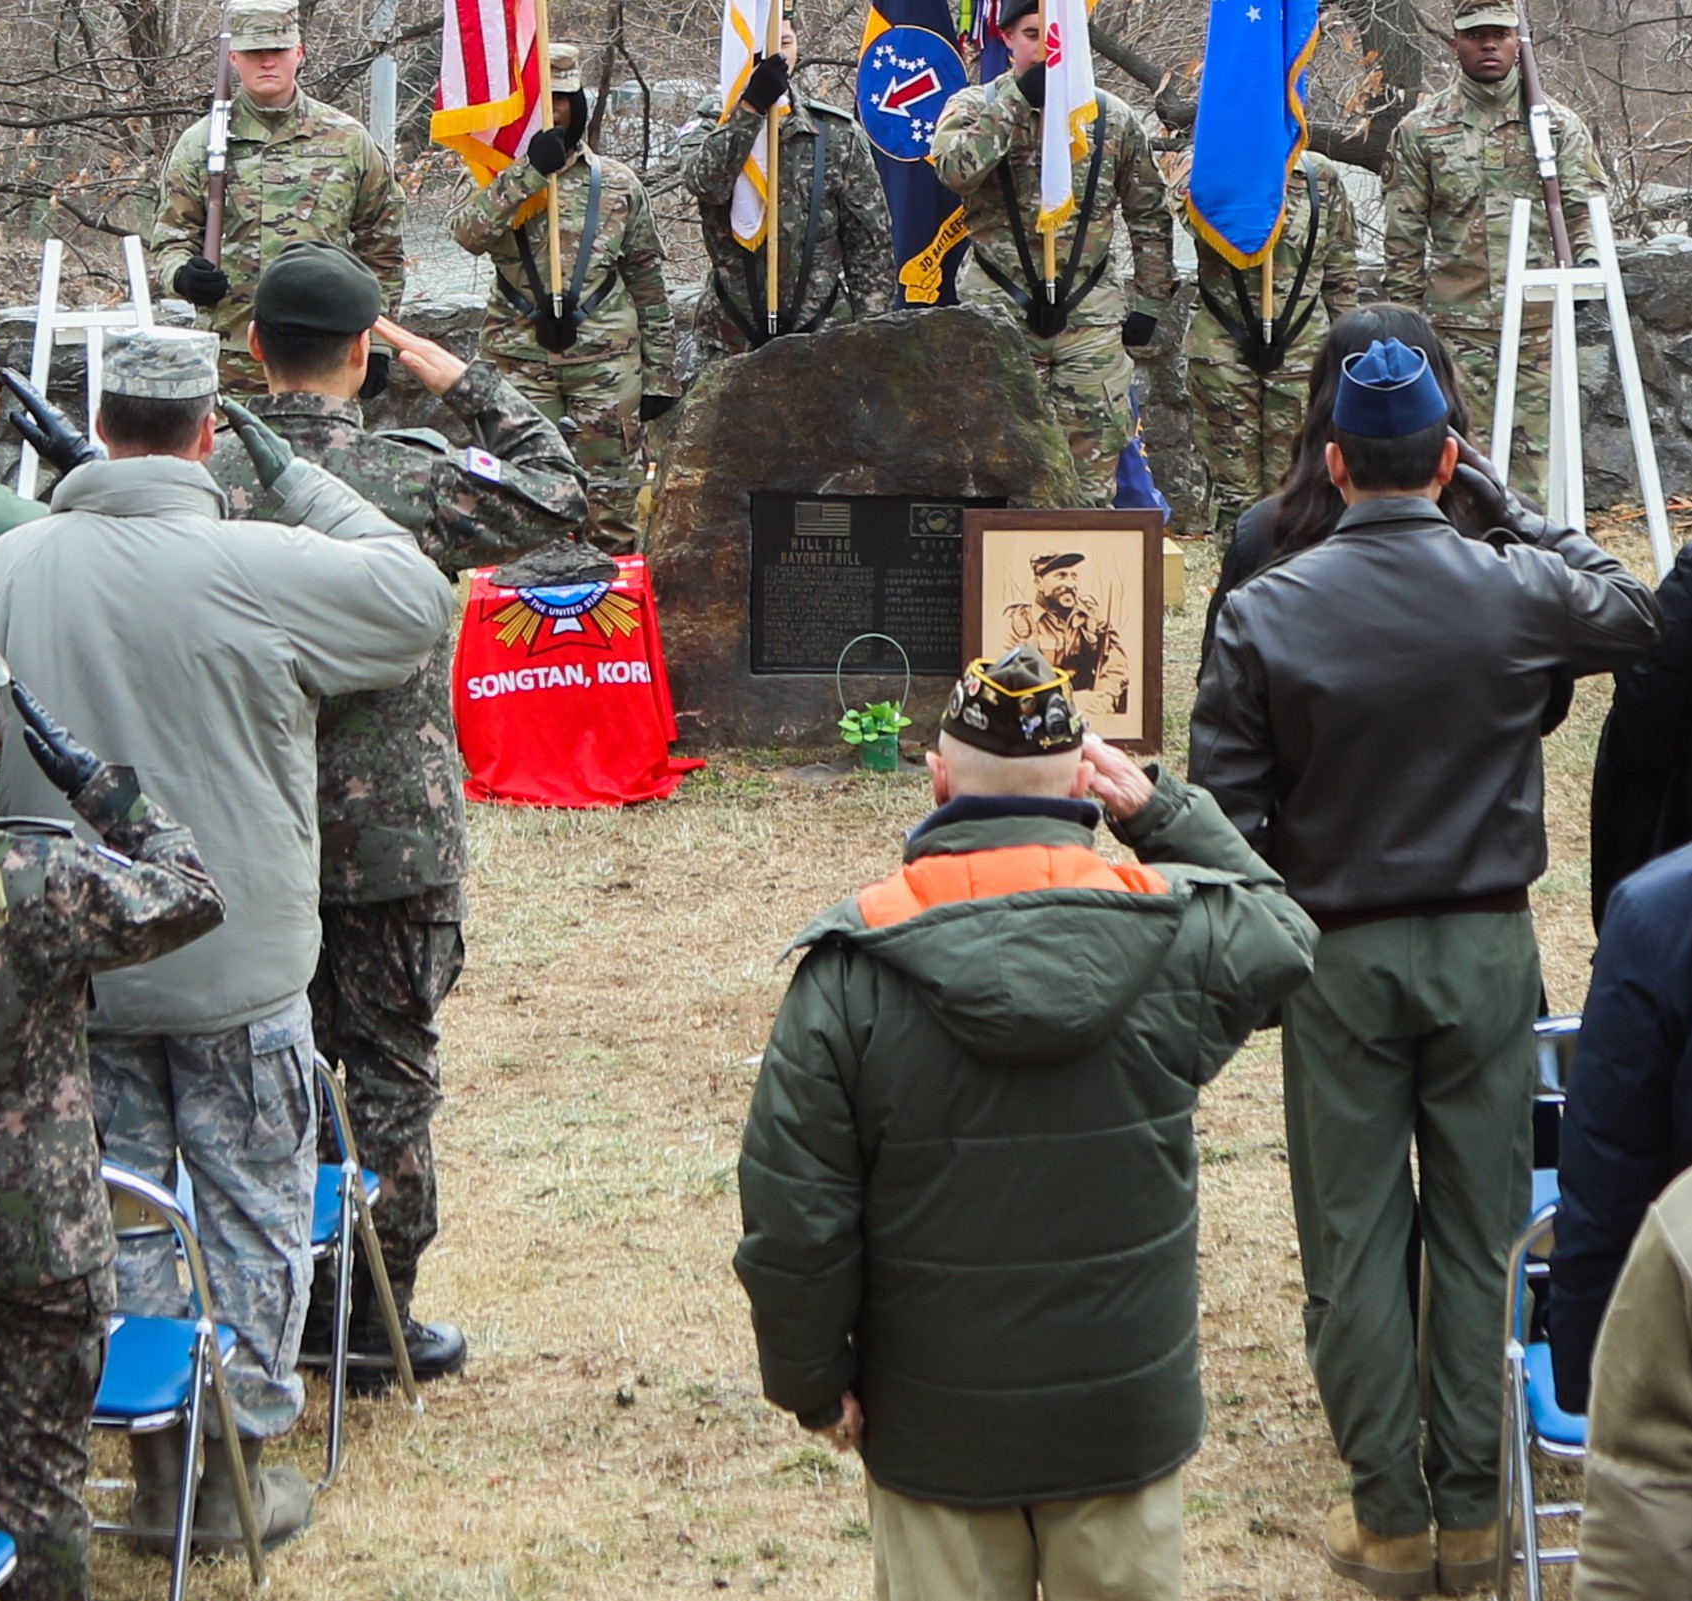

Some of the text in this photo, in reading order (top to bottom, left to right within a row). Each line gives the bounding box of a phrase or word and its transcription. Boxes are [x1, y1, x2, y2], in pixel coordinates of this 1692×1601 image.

[790, 538, 851, 551] HILL 180
[780, 552, 861, 566] BAYONET HILL
[530, 598, 547, 613] THE
[549, 601, 584, 616] UNITED
[467, 663, 593, 700] SONGTAN,
